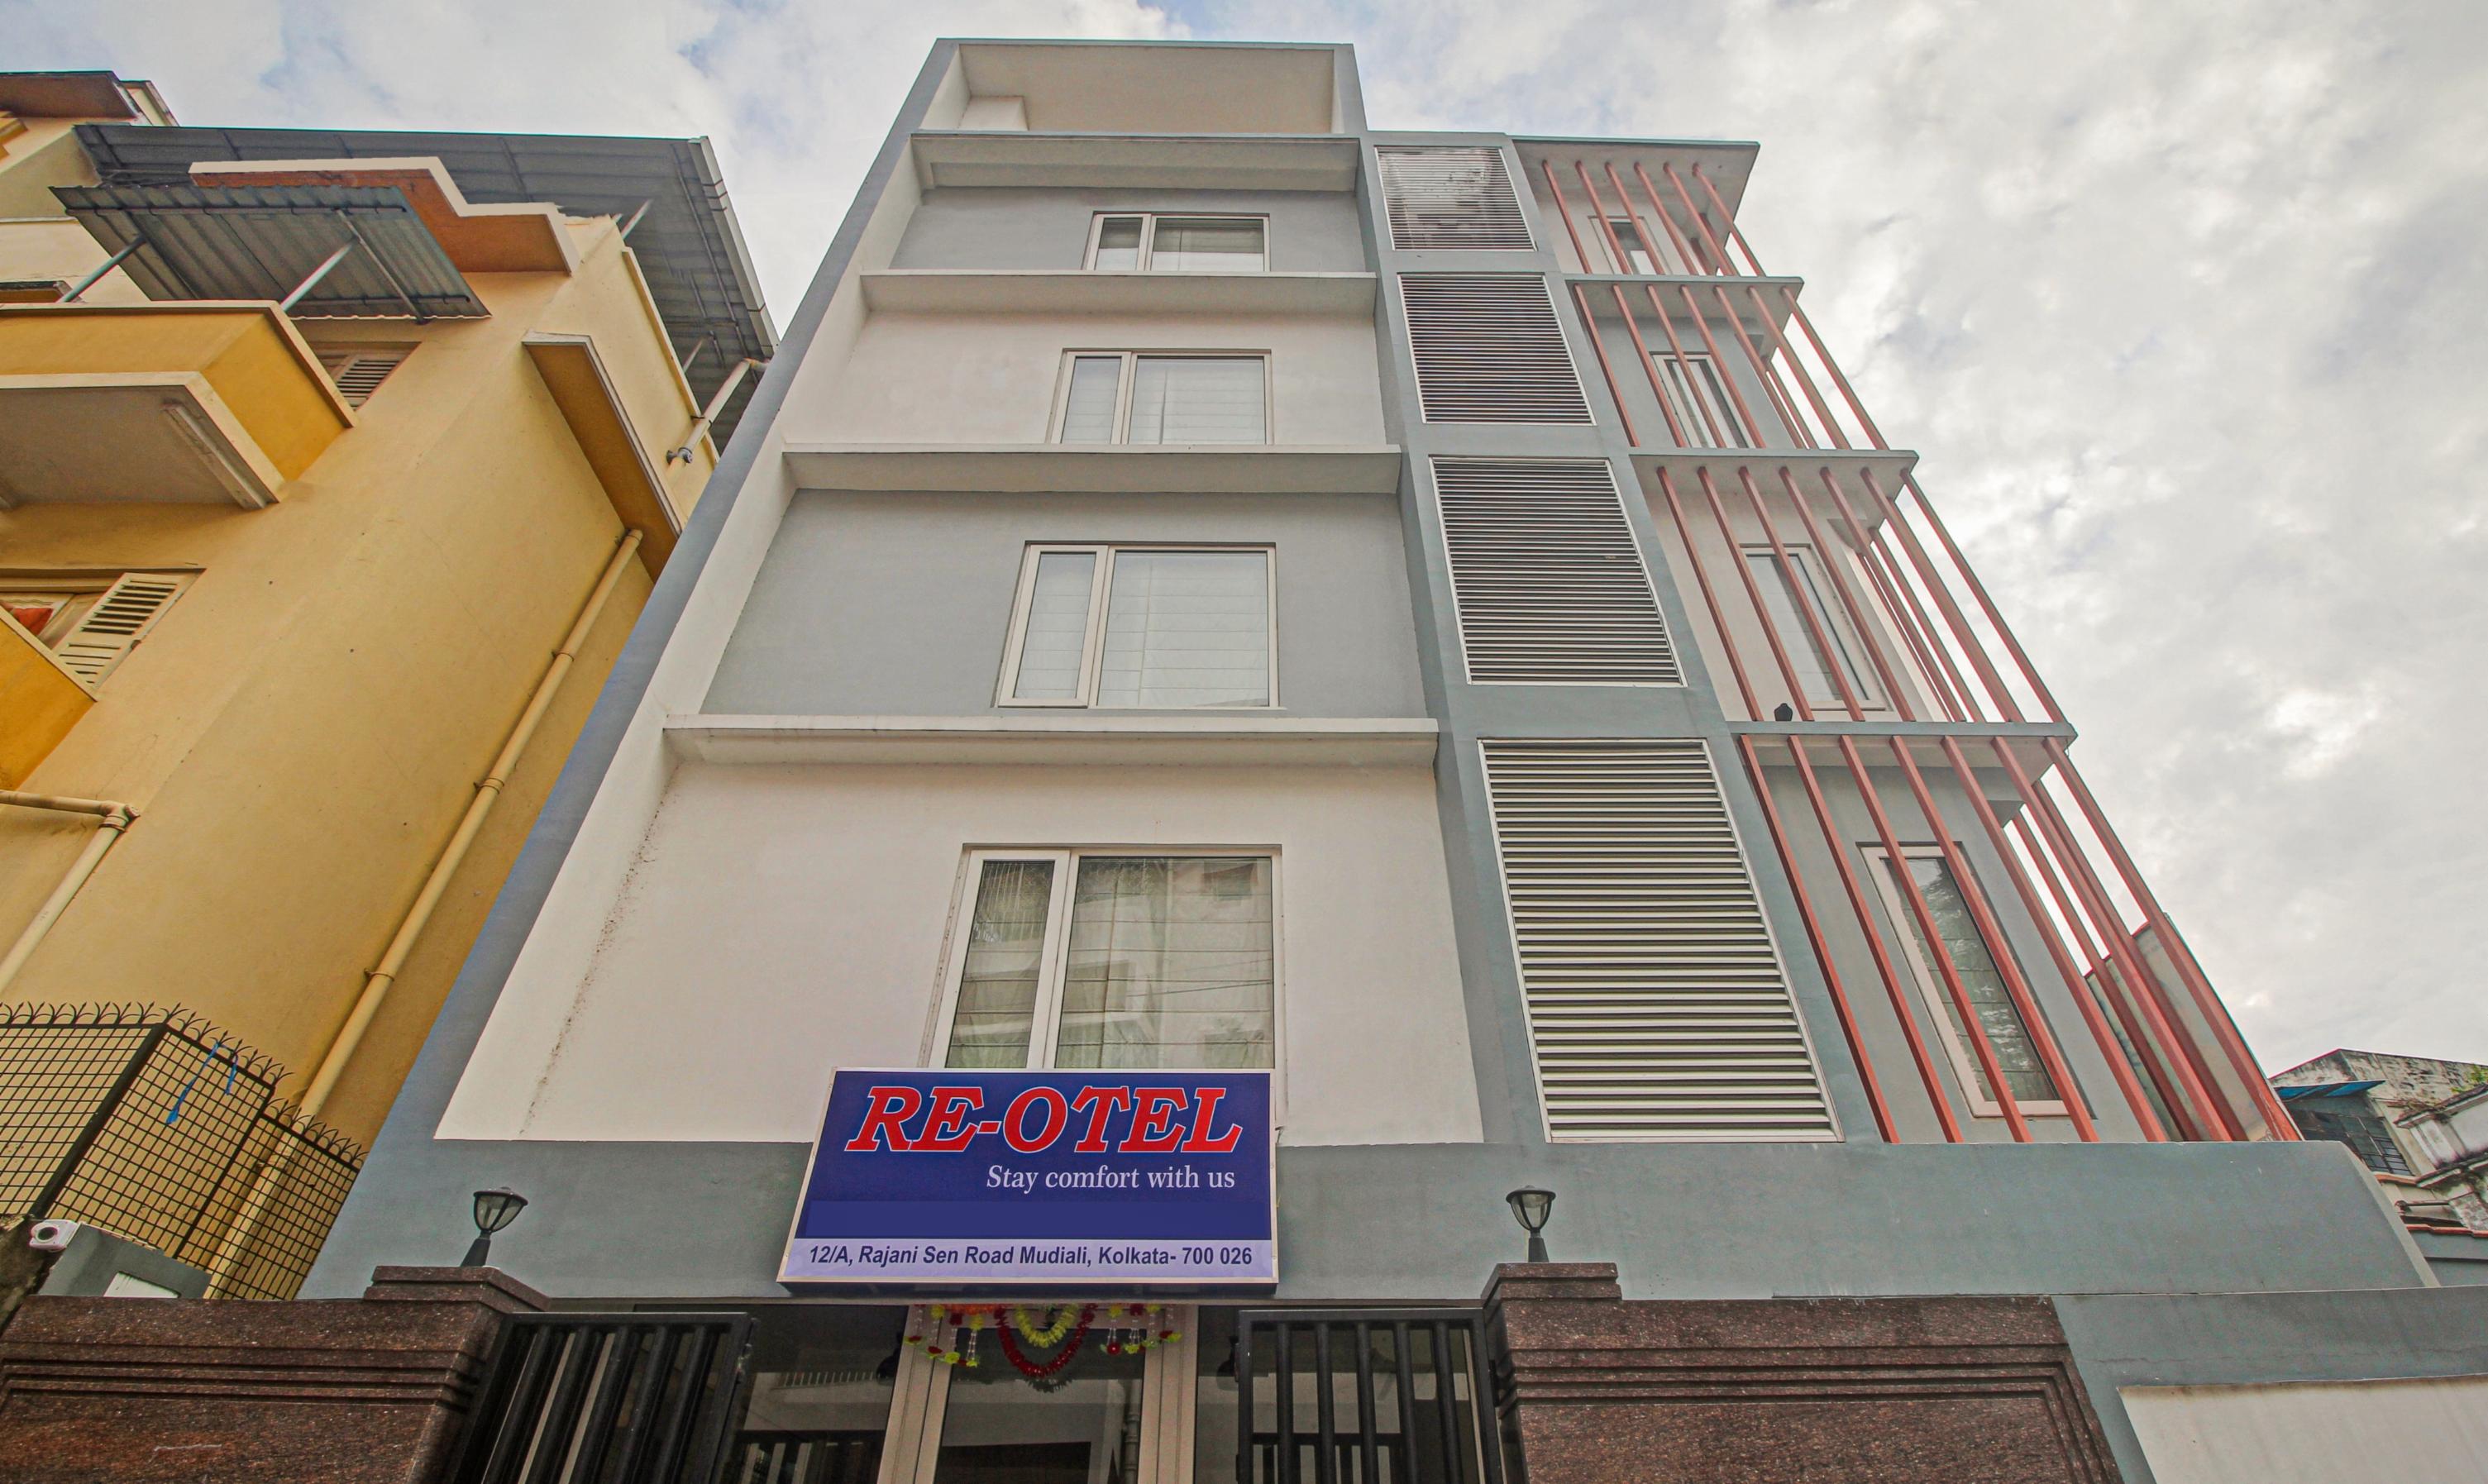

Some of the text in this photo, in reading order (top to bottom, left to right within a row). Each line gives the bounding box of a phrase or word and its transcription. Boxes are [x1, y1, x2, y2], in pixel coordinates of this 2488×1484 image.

[844, 1086, 1243, 1153] RE-OTEL
[986, 1164, 1235, 1194] Stay comfort with us
[809, 1245, 853, 1267] 12/A,
[857, 1245, 919, 1268] Rajani
[923, 1245, 958, 1264] Sen
[964, 1246, 1014, 1264] Road
[1020, 1246, 1091, 1267] Mudiali,
[1182, 1247, 1214, 1265] 700
[1220, 1247, 1253, 1265] 026
